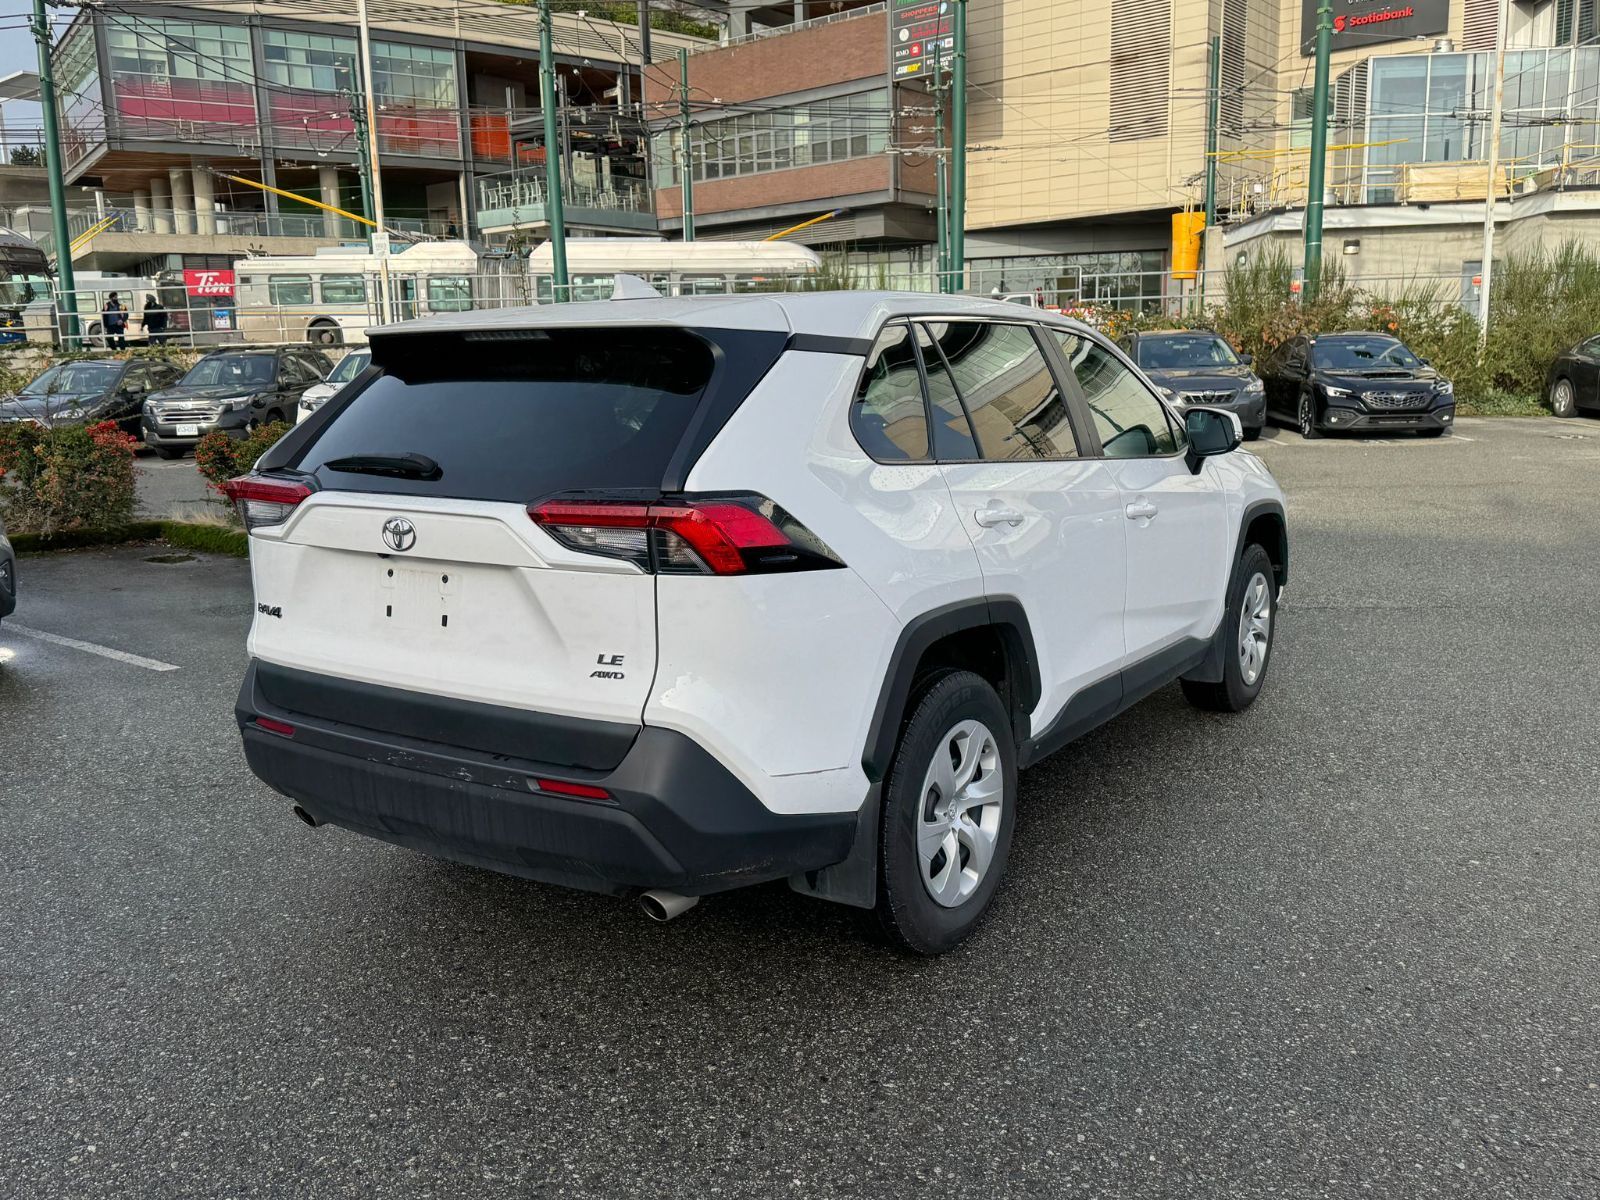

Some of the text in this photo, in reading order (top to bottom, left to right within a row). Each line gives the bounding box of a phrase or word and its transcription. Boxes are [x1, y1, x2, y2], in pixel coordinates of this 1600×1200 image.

[901, 5, 938, 19] SHOPPERS
[1350, 7, 1413, 26] Scotiabank
[896, 49, 909, 57] BMO
[195, 272, 230, 294] Tim
[597, 653, 625, 666] LE
[590, 670, 625, 680] AWD
